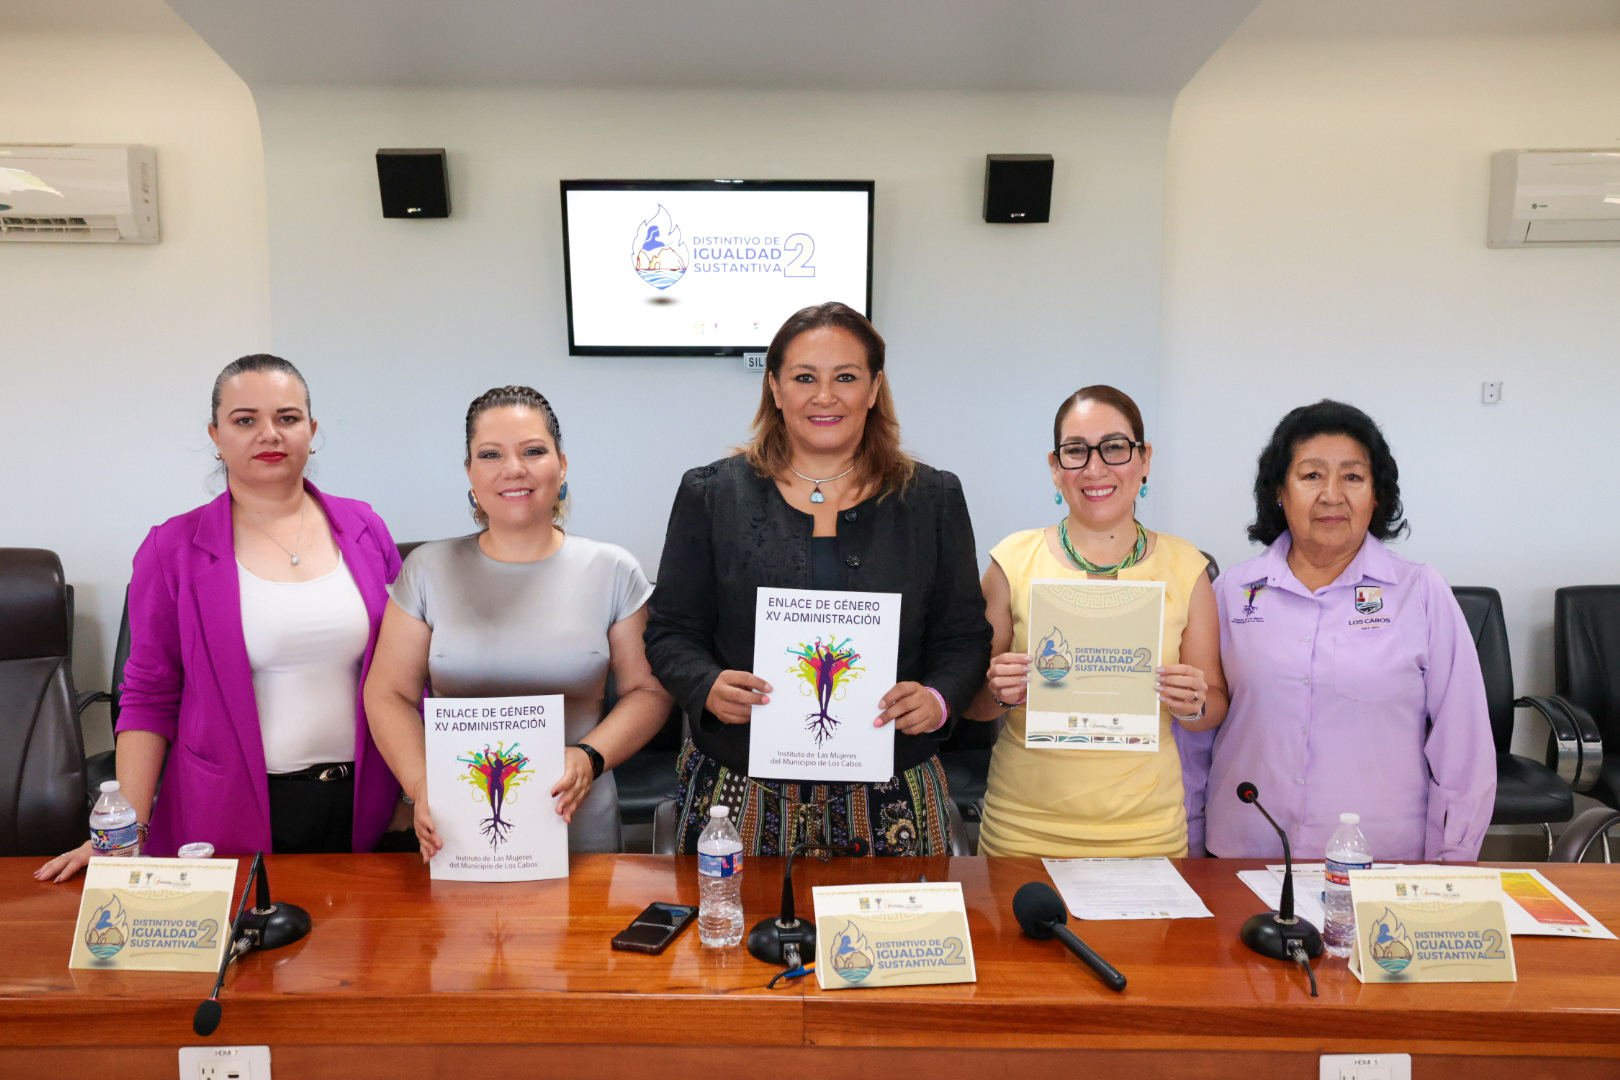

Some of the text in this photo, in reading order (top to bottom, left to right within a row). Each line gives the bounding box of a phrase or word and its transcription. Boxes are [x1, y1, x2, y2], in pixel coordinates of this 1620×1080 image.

[693, 236, 780, 245] DISTINTIVO DE
[693, 248, 782, 260] IGUALDAD
[783, 232, 816, 278] 2
[693, 262, 782, 273] SUSTANTIVA
[748, 357, 767, 368] SIL
[768, 597, 880, 612] ENLACE DE GÉNERO
[766, 611, 881, 625] XV ADMINISTRACIÓN
[1075, 647, 1120, 655] DISTINTIVO
[1075, 654, 1134, 664] IGUALDAD
[1133, 647, 1152, 673] 2
[1074, 664, 1134, 673] SUSTANTIVA
[436, 705, 545, 718] ENLACE DE GÉNERO
[434, 718, 546, 731] XV ADMINISTRACIÓN
[777, 750, 805, 758] Instituto
[829, 752, 857, 760] Mujeres
[782, 758, 817, 767] Municipio
[505, 854, 533, 862] Mujeres
[133, 919, 198, 928] DISTINTIVO DE
[131, 927, 198, 938] IGUALDAD
[197, 918, 219, 949] 2
[1414, 931, 1481, 939] DISTINTIVO DE
[129, 938, 197, 948] SUSTANTIVA
[875, 939, 942, 949] DISTINTIVO DE
[1415, 939, 1483, 950] IGUALDAD
[1481, 928, 1506, 960] 2
[876, 947, 944, 960] IGUALDAD
[942, 936, 966, 966] 2
[1417, 951, 1487, 960] SUSTANTIVA
[878, 958, 947, 969] SUSTANTIVA
